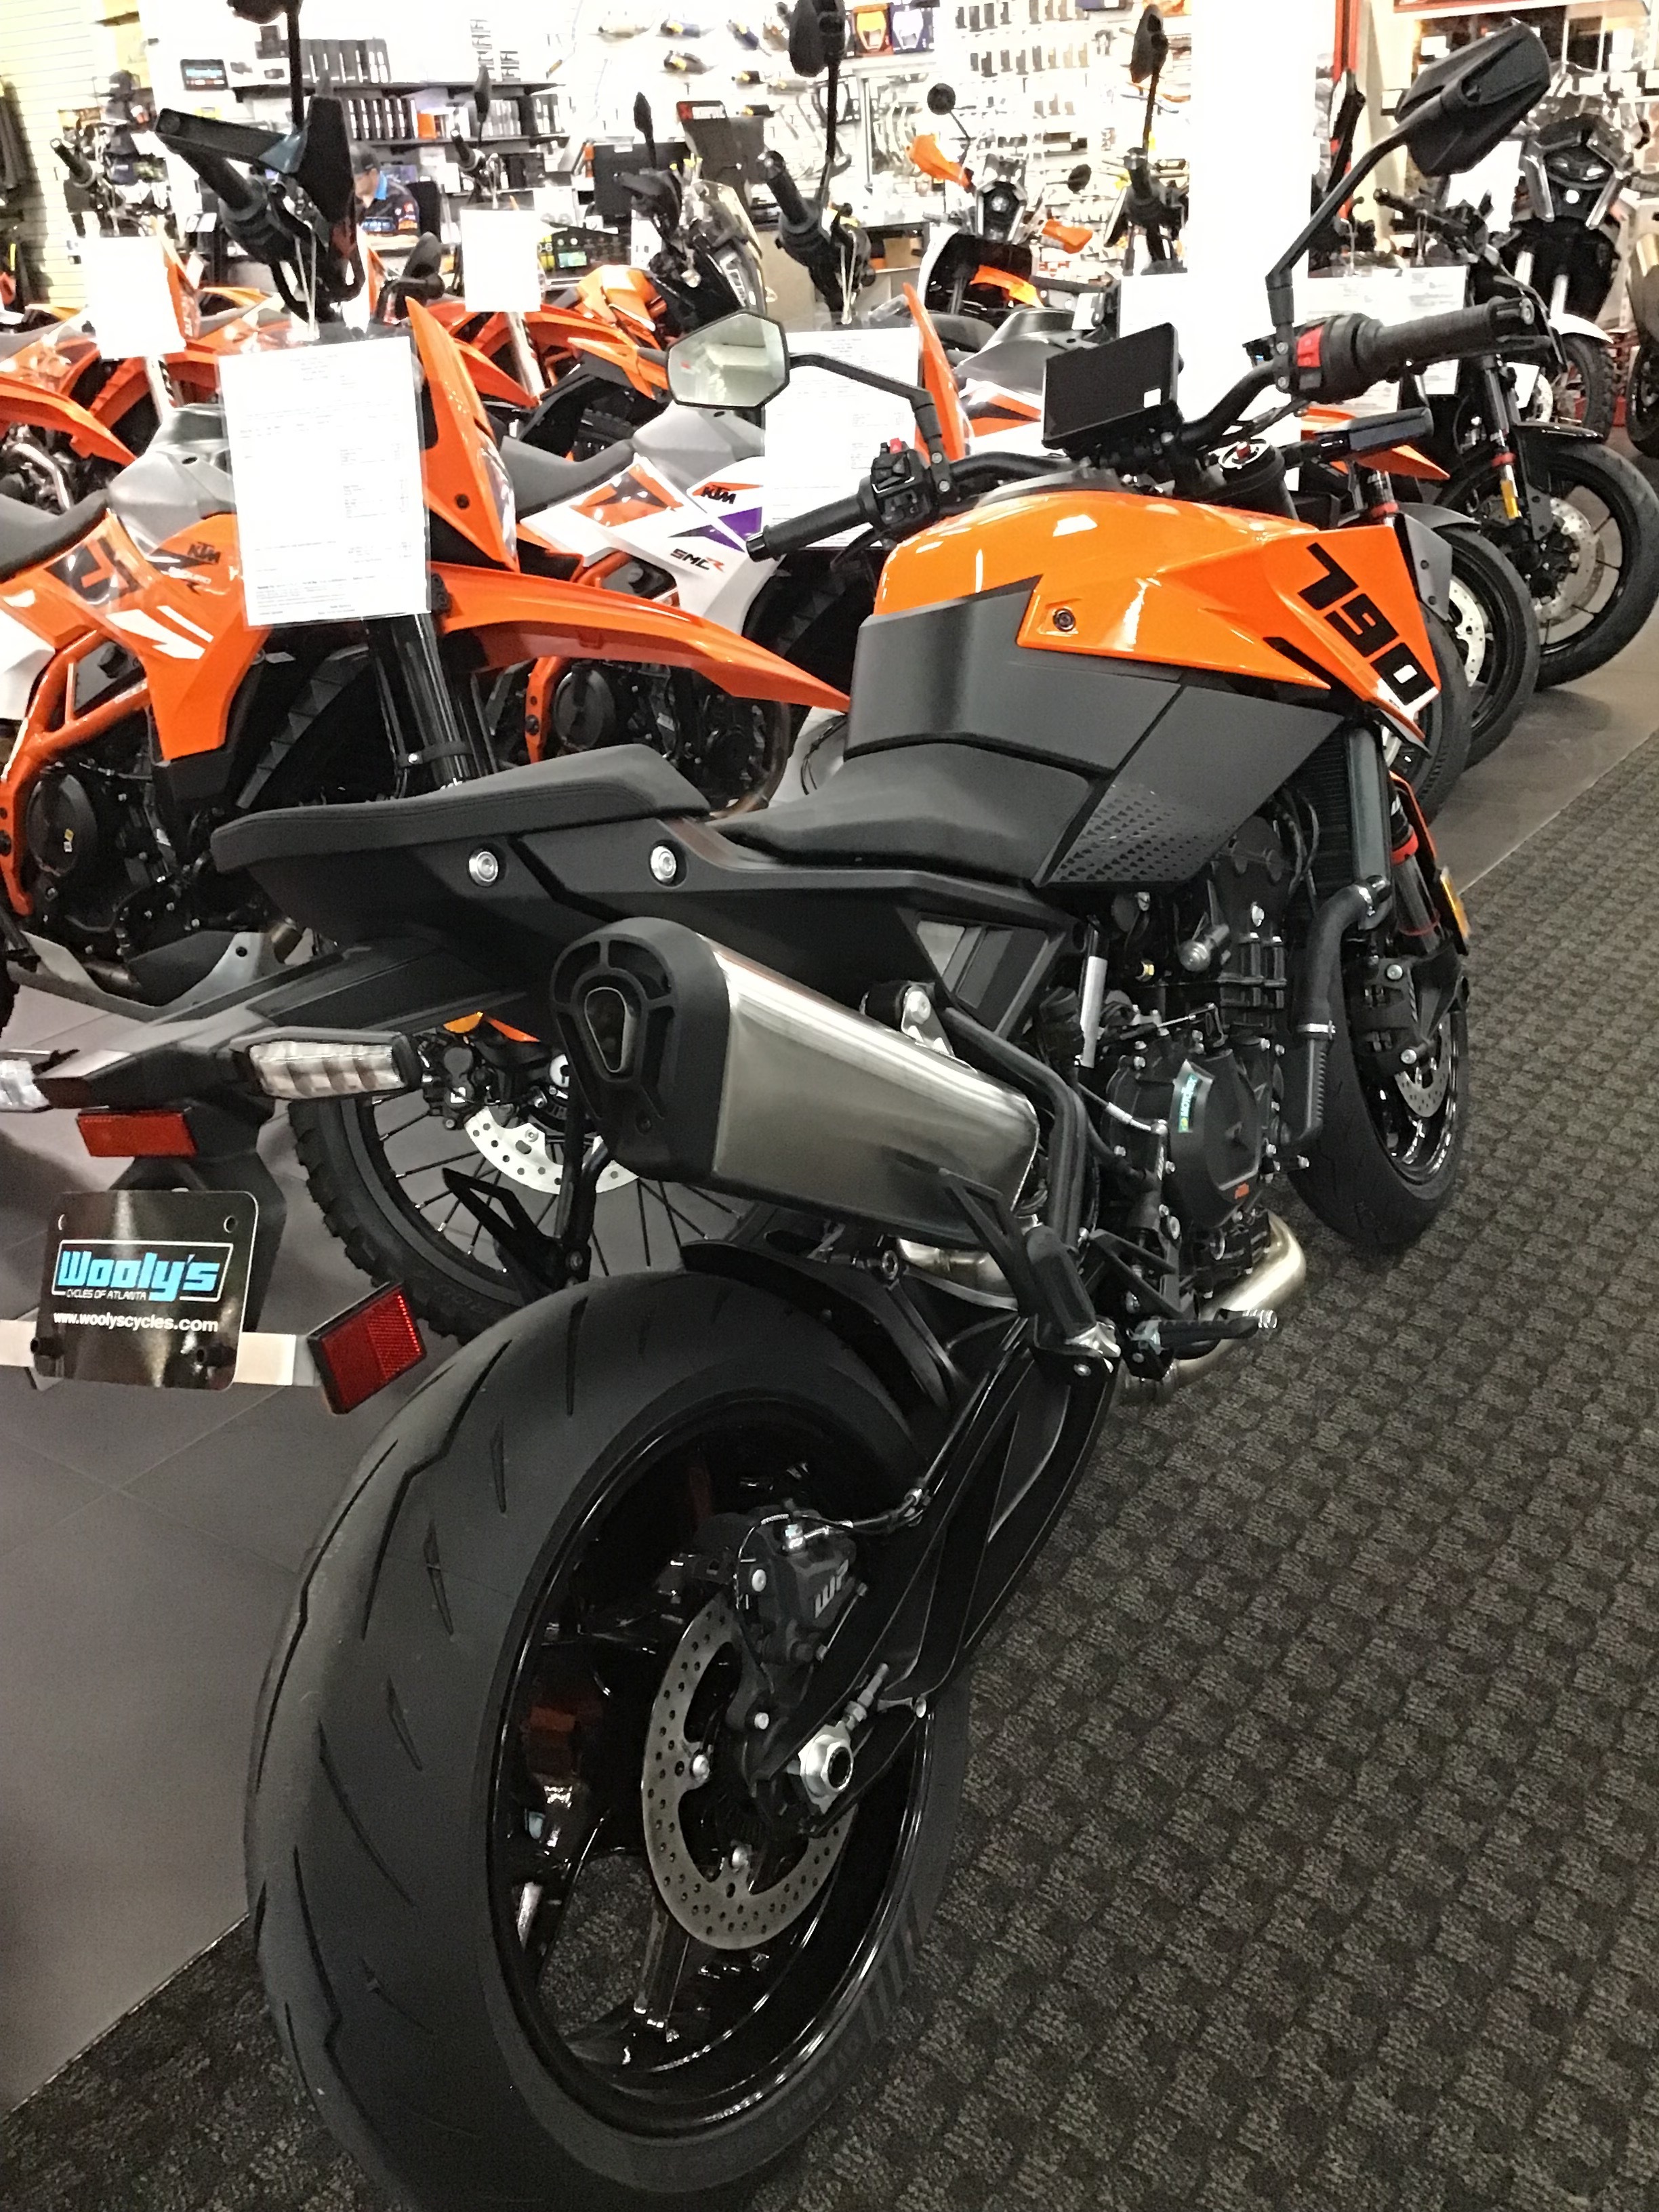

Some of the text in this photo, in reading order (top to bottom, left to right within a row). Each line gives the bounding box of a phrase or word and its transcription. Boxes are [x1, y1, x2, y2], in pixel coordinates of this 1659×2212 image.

[701, 485, 737, 505] KTM
[187, 541, 222, 564] KTM
[1297, 541, 1437, 706] 790
[57, 1250, 221, 1302] Wooly's
[65, 1288, 147, 1301] CYCLES OF ATLANTA
[53, 1311, 219, 1332] www.woolyscycles.com
